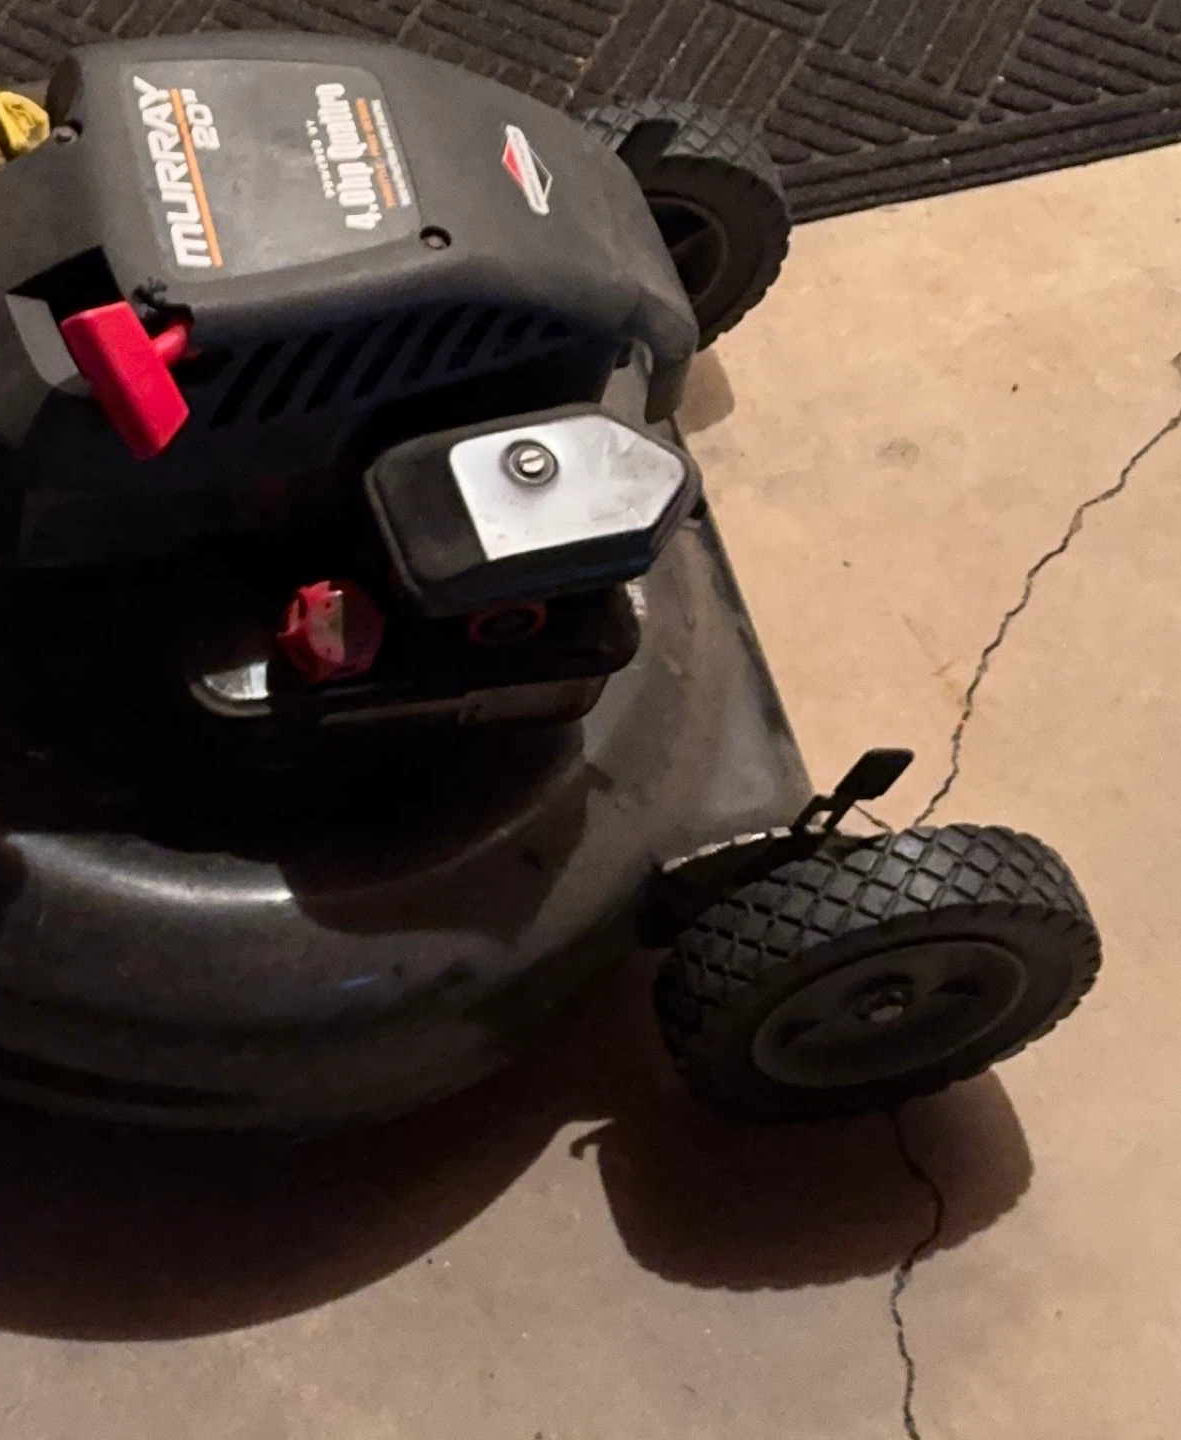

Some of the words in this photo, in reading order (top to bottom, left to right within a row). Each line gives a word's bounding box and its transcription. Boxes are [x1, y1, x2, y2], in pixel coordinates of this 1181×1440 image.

[181, 88, 220, 150] 20"
[315, 83, 368, 161] Quattro
[133, 75, 213, 268] MURRAY
[336, 162, 382, 230] 4.0hp
